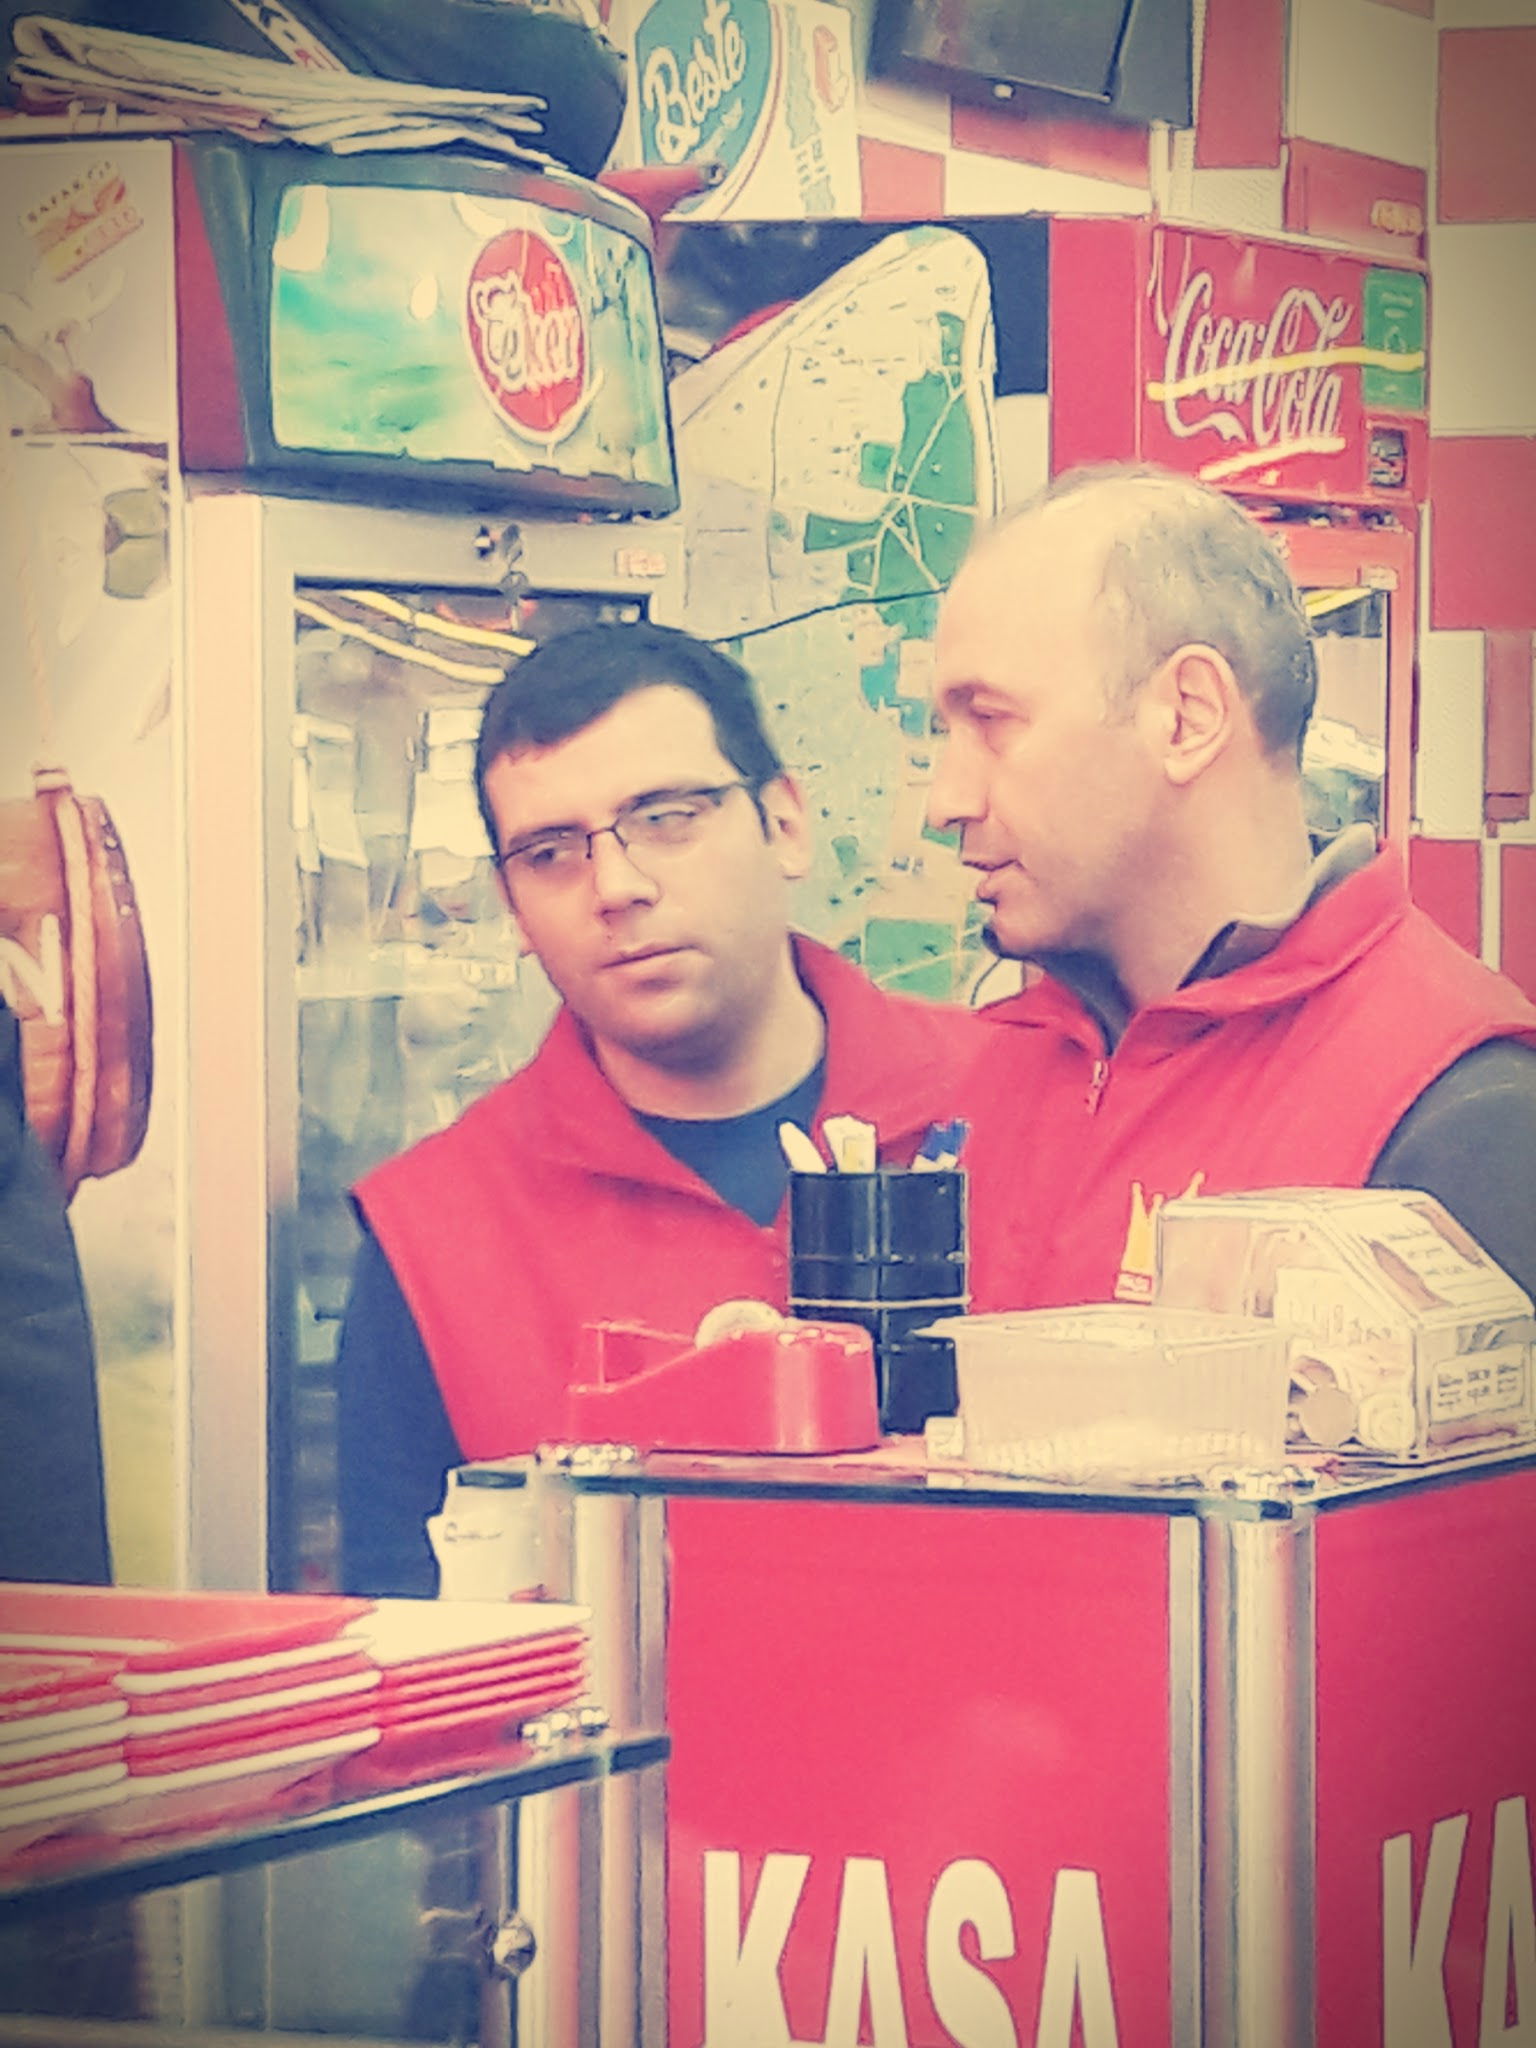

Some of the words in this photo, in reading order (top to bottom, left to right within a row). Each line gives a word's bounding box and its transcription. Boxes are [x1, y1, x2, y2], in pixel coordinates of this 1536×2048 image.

[643, 0, 747, 165] Beste
[470, 268, 582, 393] Eker
[703, 1849, 1120, 2048] KASA
